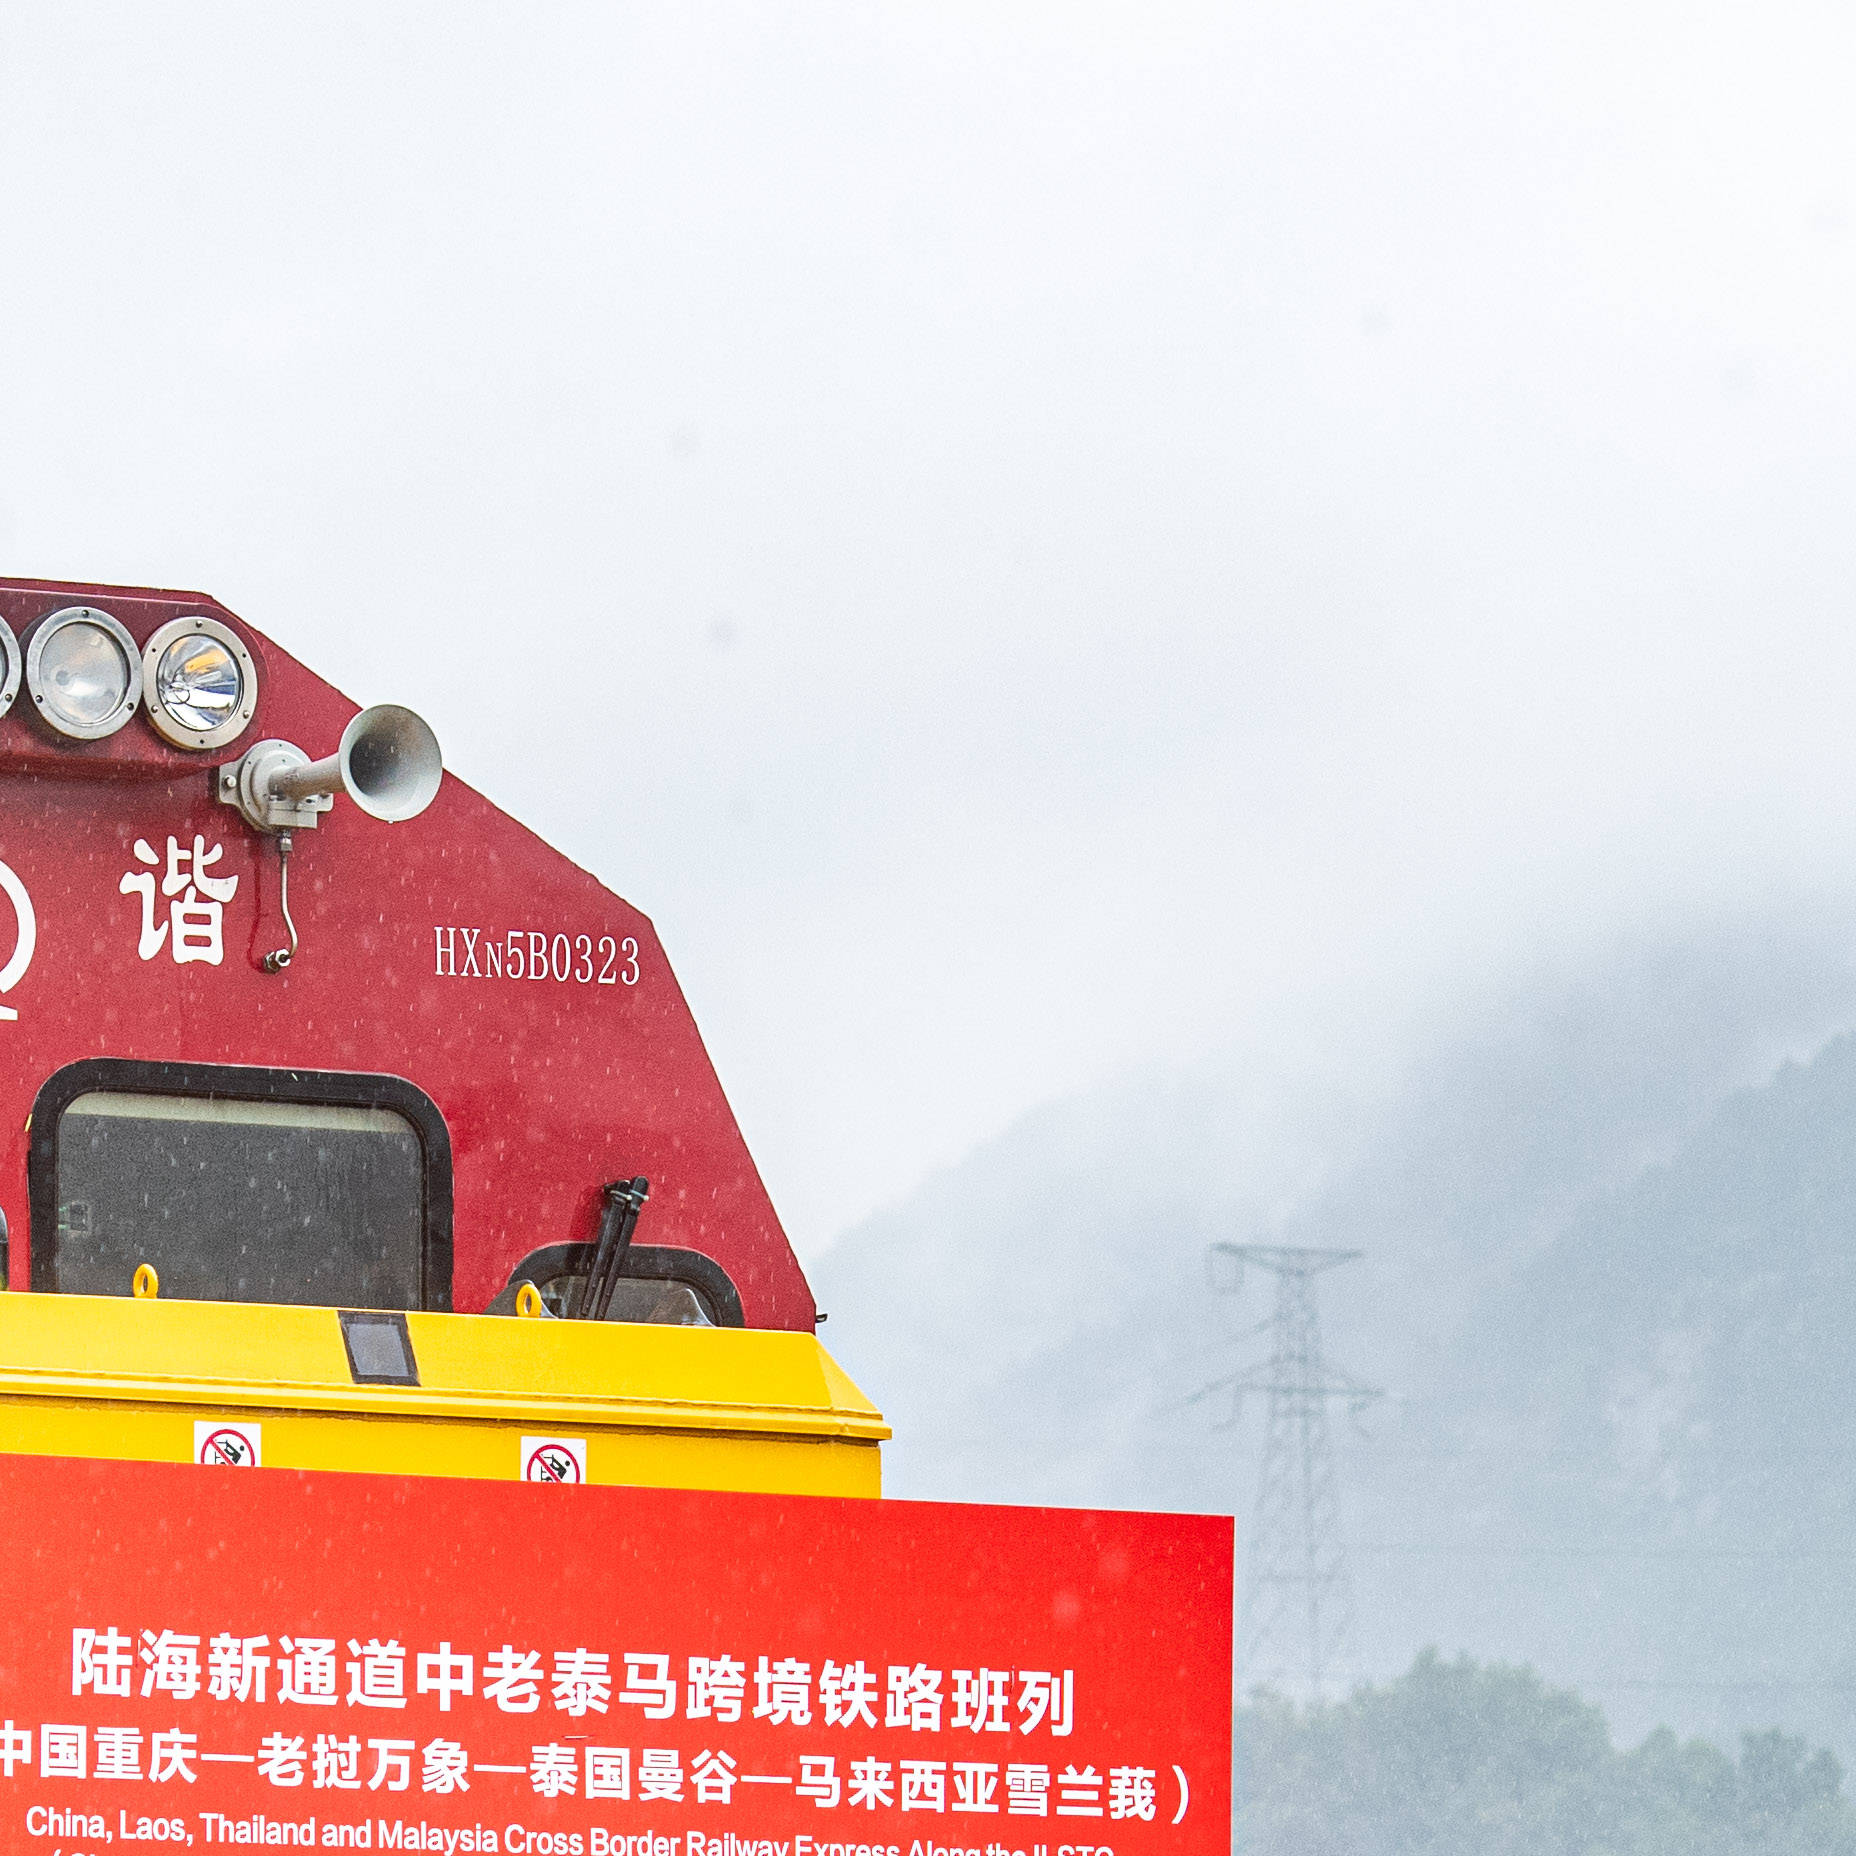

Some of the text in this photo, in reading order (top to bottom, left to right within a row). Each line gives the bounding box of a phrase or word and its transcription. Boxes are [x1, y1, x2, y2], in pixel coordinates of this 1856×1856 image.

[119, 834, 238, 966] 谐
[434, 926, 641, 986] HXN5B0323
[71, 1626, 1076, 1737] 陆海新通道中老泰马跨境铁路班列
[26, 1804, 113, 1844] China,
[119, 1809, 194, 1848] Laos,
[198, 1812, 316, 1847] Thailand
[321, 1818, 372, 1849] and
[378, 1819, 499, 1856] Malaysia
[504, 1823, 584, 1856] Cross
